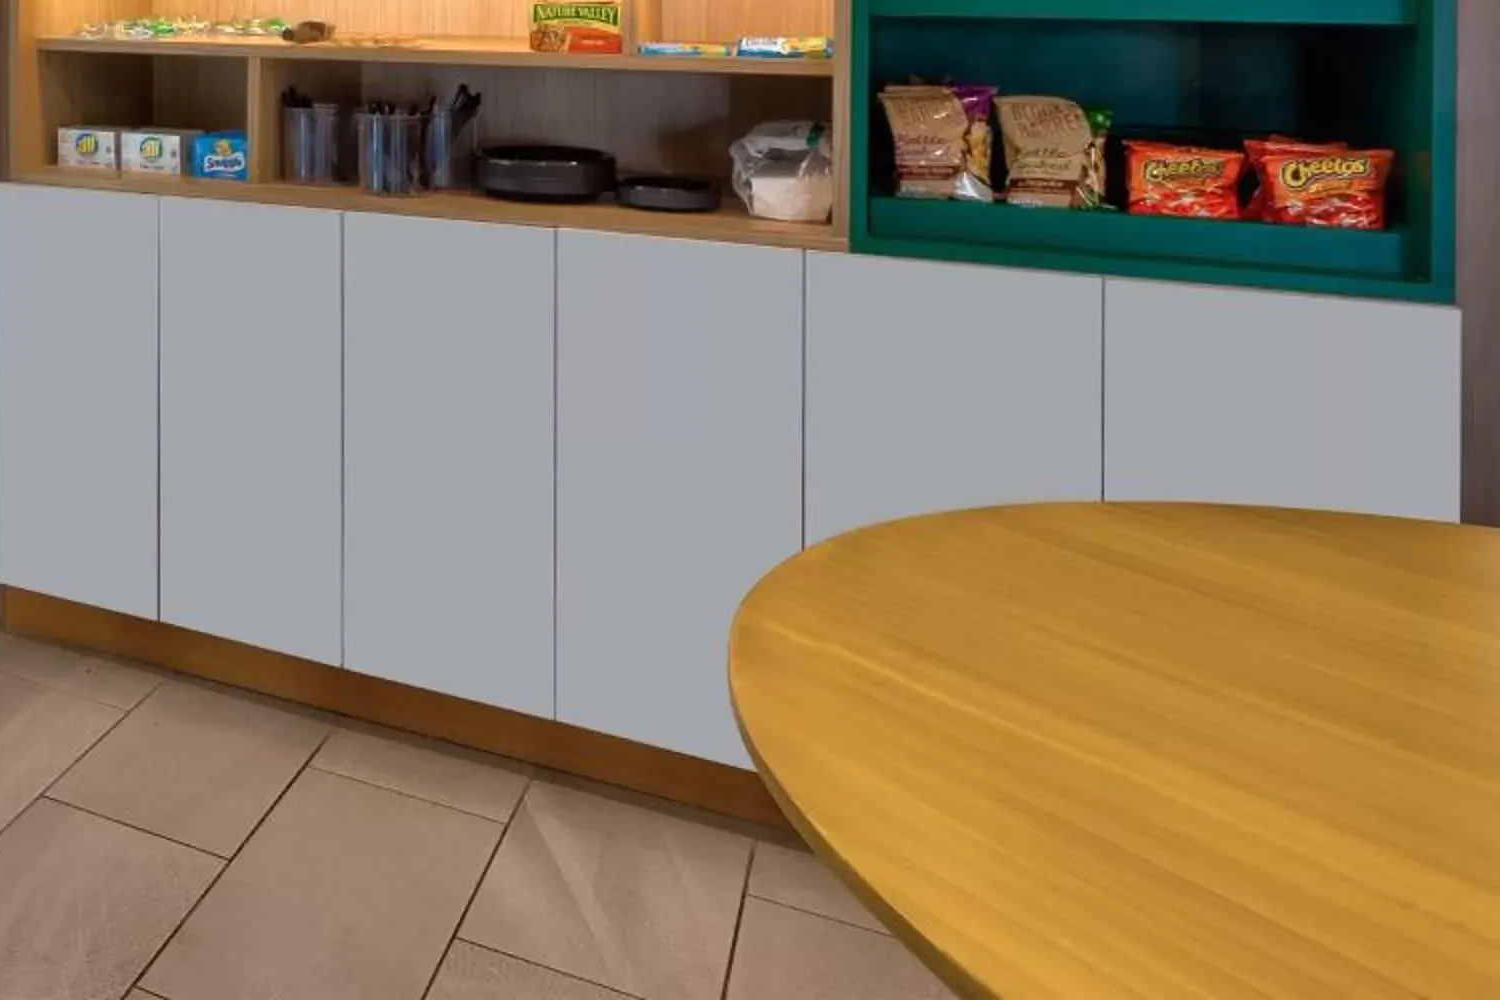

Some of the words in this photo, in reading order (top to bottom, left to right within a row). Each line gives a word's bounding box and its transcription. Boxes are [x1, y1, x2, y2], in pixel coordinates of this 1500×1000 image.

[537, 5, 575, 19] NATURE
[577, 6, 617, 23] VALLEY
[1145, 159, 1222, 182] Cheetos
[1281, 156, 1367, 188] Cheetos
